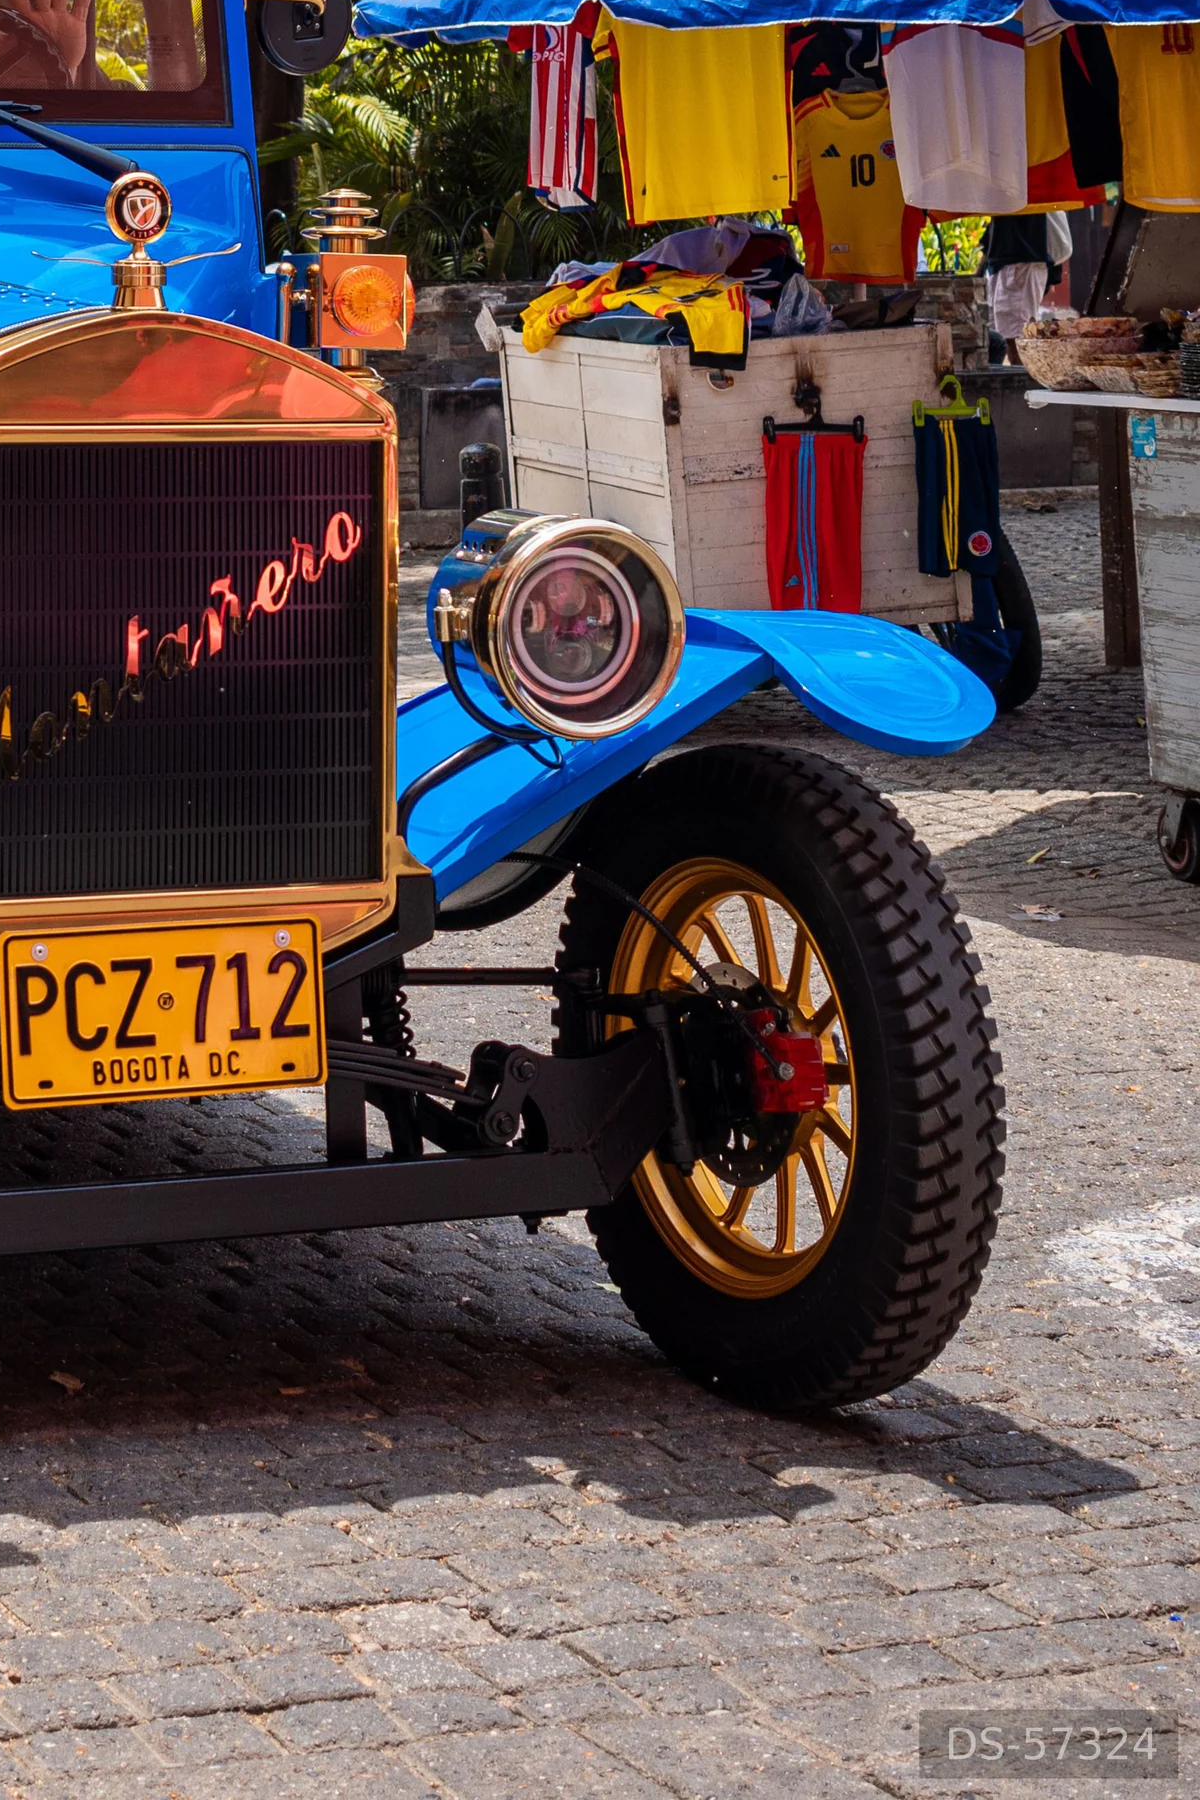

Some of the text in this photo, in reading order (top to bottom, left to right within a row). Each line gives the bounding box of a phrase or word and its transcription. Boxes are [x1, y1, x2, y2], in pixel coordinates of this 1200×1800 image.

[851, 154, 875, 187] 10
[15, 949, 311, 1056] PCZ 712
[93, 1051, 247, 1086] BOGOTA D.C.
